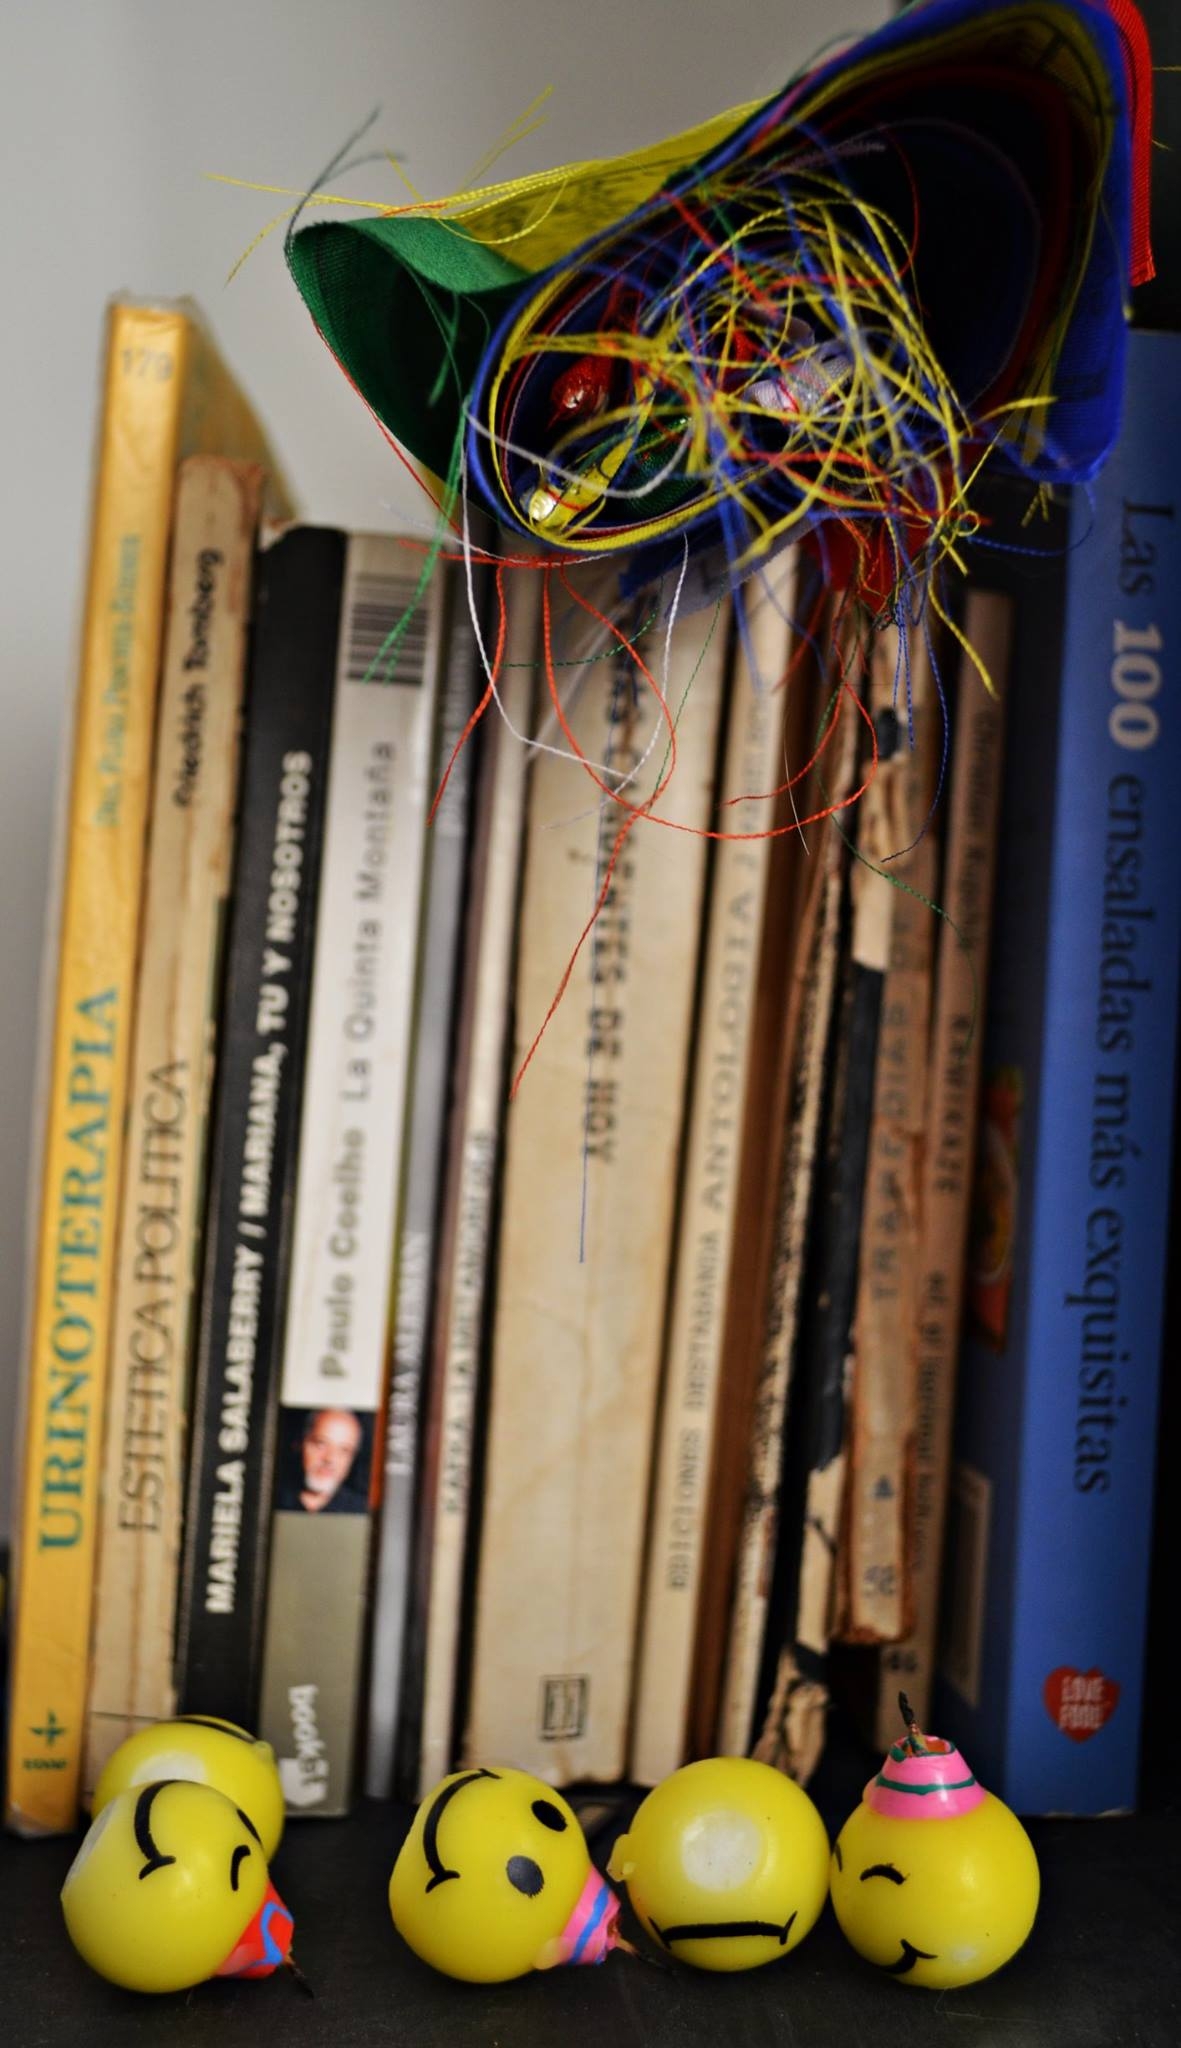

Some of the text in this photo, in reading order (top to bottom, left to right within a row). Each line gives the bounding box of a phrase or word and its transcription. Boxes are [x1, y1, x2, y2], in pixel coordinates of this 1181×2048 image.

[266, 749, 313, 944] NOSOTROS
[342, 739, 397, 1104] La Quinta Montaña
[256, 984, 289, 1037] TU
[262, 950, 292, 976] Y
[586, 1008, 624, 1058] DE
[1062, 501, 1175, 1496] Las 100 ensaladas más exquisitas
[136, 1058, 188, 1285] POLITICA
[239, 1042, 289, 1217] MARIANA,
[581, 1080, 618, 1162] HOY
[38, 985, 119, 1554] URINOTERAPIA
[218, 1246, 264, 1453] SALABERRY
[320, 1128, 366, 1380] Paulo Coelho
[205, 1459, 247, 1612] MARIELA
